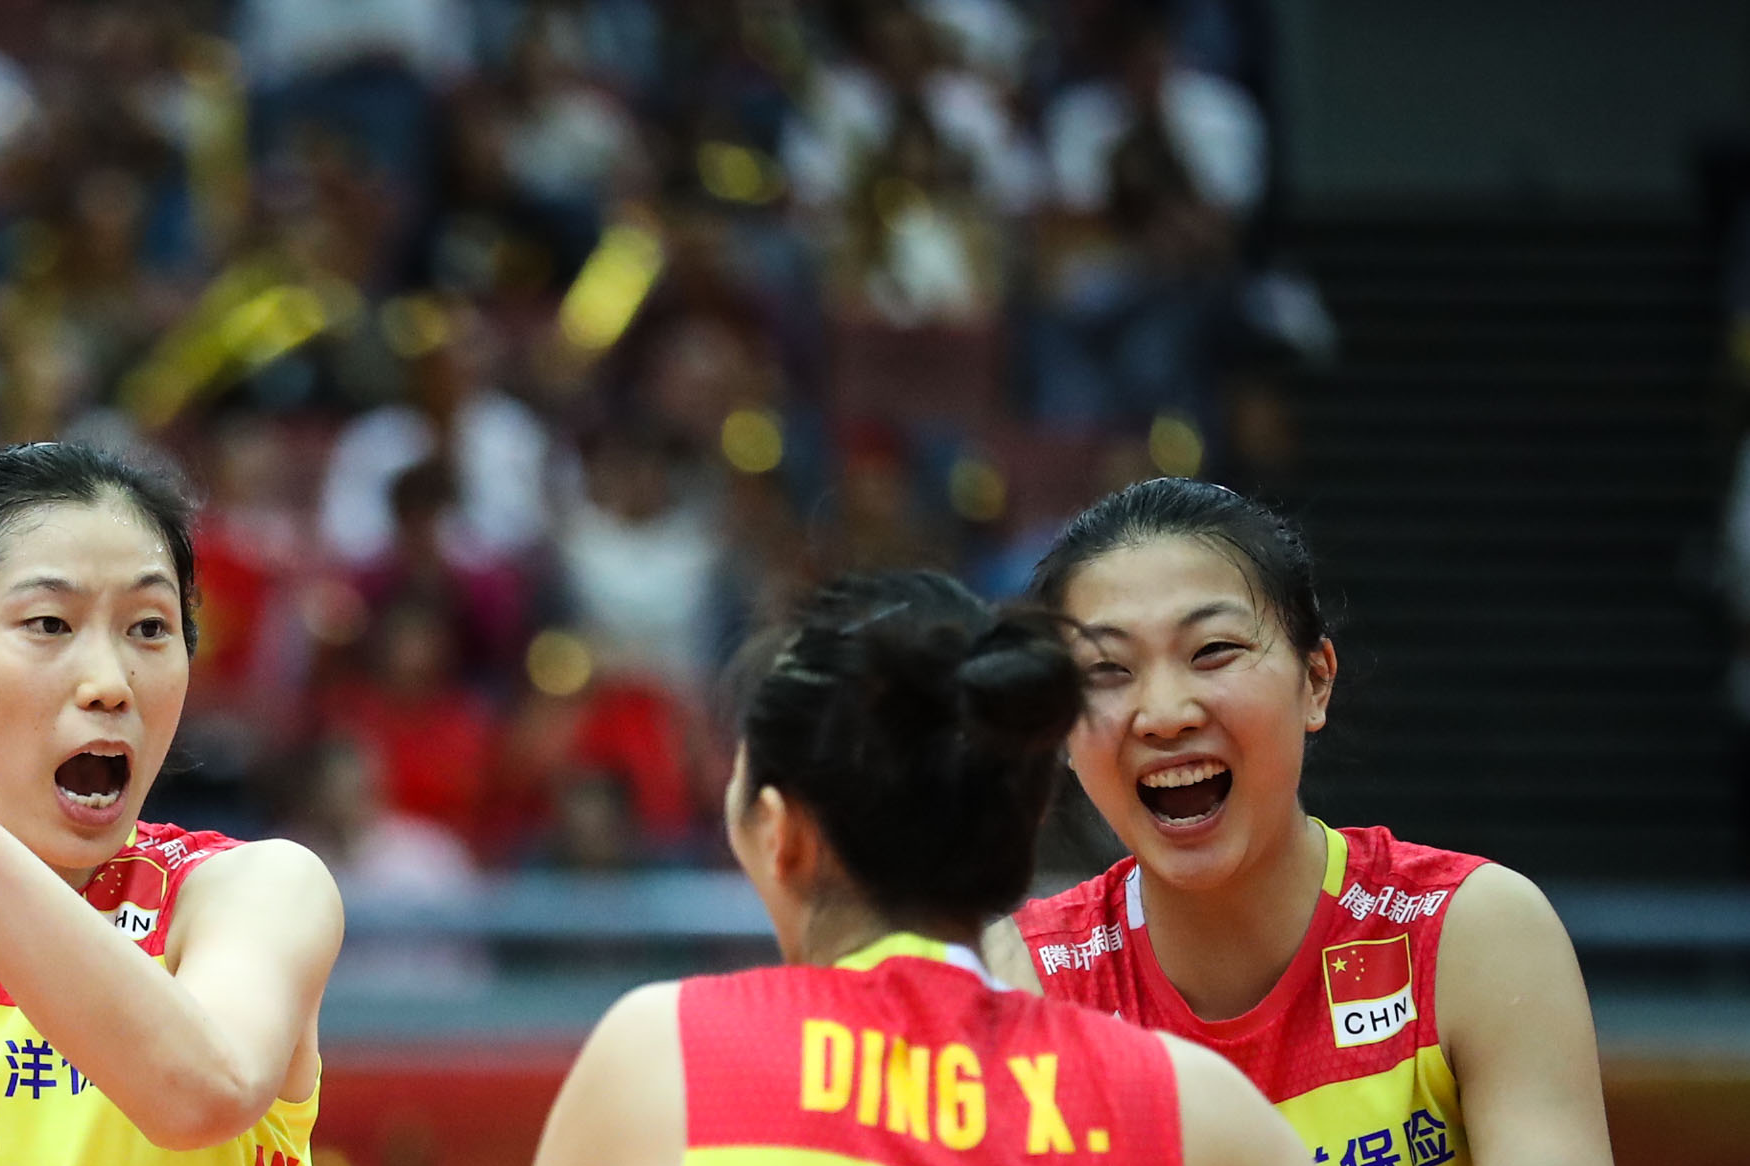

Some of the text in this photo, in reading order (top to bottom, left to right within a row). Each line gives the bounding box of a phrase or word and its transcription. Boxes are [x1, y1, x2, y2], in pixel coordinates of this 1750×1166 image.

[115, 909, 151, 933] HN
[1344, 996, 1408, 1035] CHN
[800, 1018, 1112, 1156] DING X.
